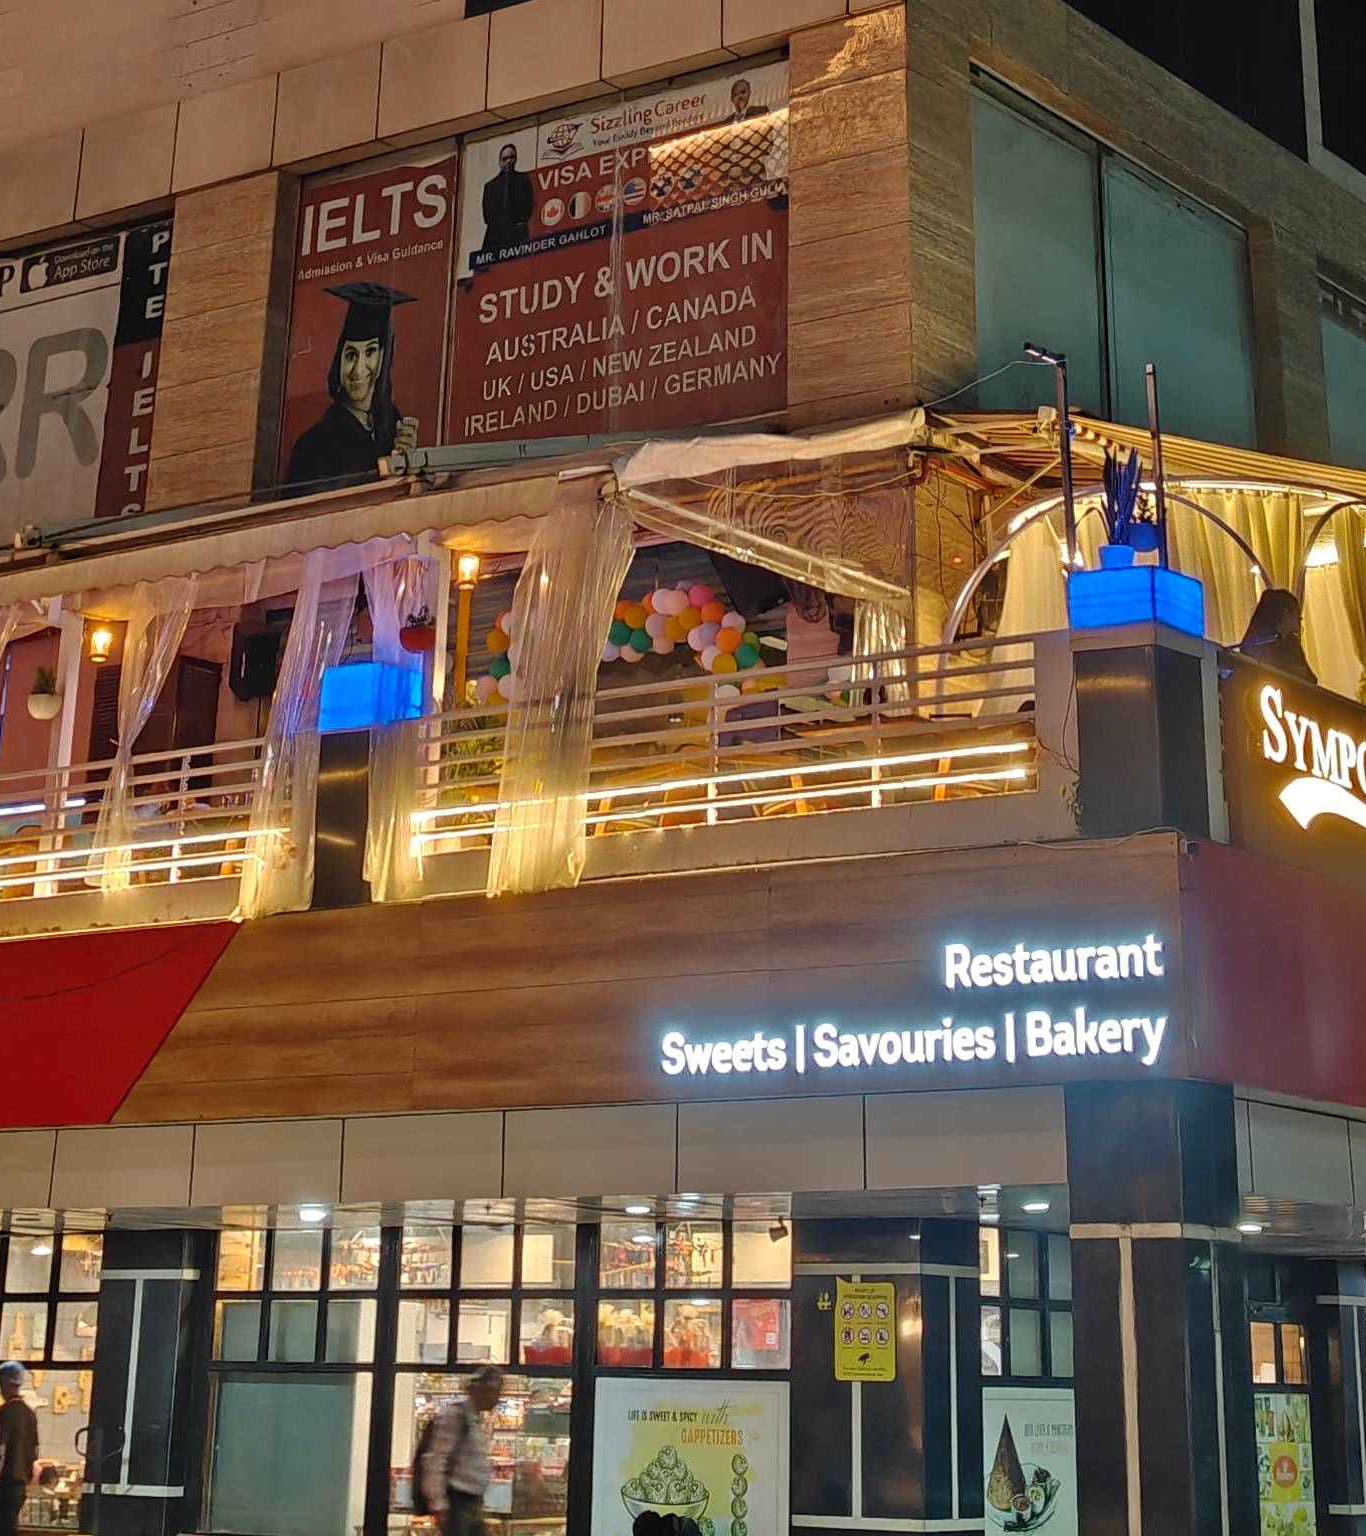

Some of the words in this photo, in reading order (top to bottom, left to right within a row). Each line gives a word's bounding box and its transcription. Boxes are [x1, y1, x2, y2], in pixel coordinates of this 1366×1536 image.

[590, 107, 653, 135] Sizzling
[654, 94, 708, 117] Career
[538, 162, 593, 192] VISA
[300, 173, 448, 257] IELTS
[53, 264, 78, 281] App
[79, 256, 111, 274] Store
[355, 255, 364, 268] &
[366, 251, 389, 266] Visa
[475, 250, 497, 265] MR.
[499, 237, 556, 259] RAVINDER
[558, 224, 608, 245] GAHLOT
[478, 271, 586, 324] STUDY
[593, 265, 616, 298] &
[625, 238, 731, 291] WORK
[741, 228, 773, 266] IN
[485, 313, 626, 366] AUSTRALIA
[645, 284, 757, 330] CANADA
[482, 377, 512, 402] UK
[530, 366, 574, 391] USA
[591, 346, 643, 378] NEW
[648, 324, 757, 368] ZEALAND
[463, 399, 558, 437] IRELAND
[576, 381, 645, 415] DUBAI
[664, 351, 782, 396] GERMANY
[944, 933, 1166, 991] Restaurant
[660, 1030, 789, 1077] Sweets
[813, 1017, 998, 1069] Savouries
[1025, 1006, 1169, 1067] Bakery
[648, 1410, 671, 1423] SWEET
[679, 1411, 698, 1423] SPICY
